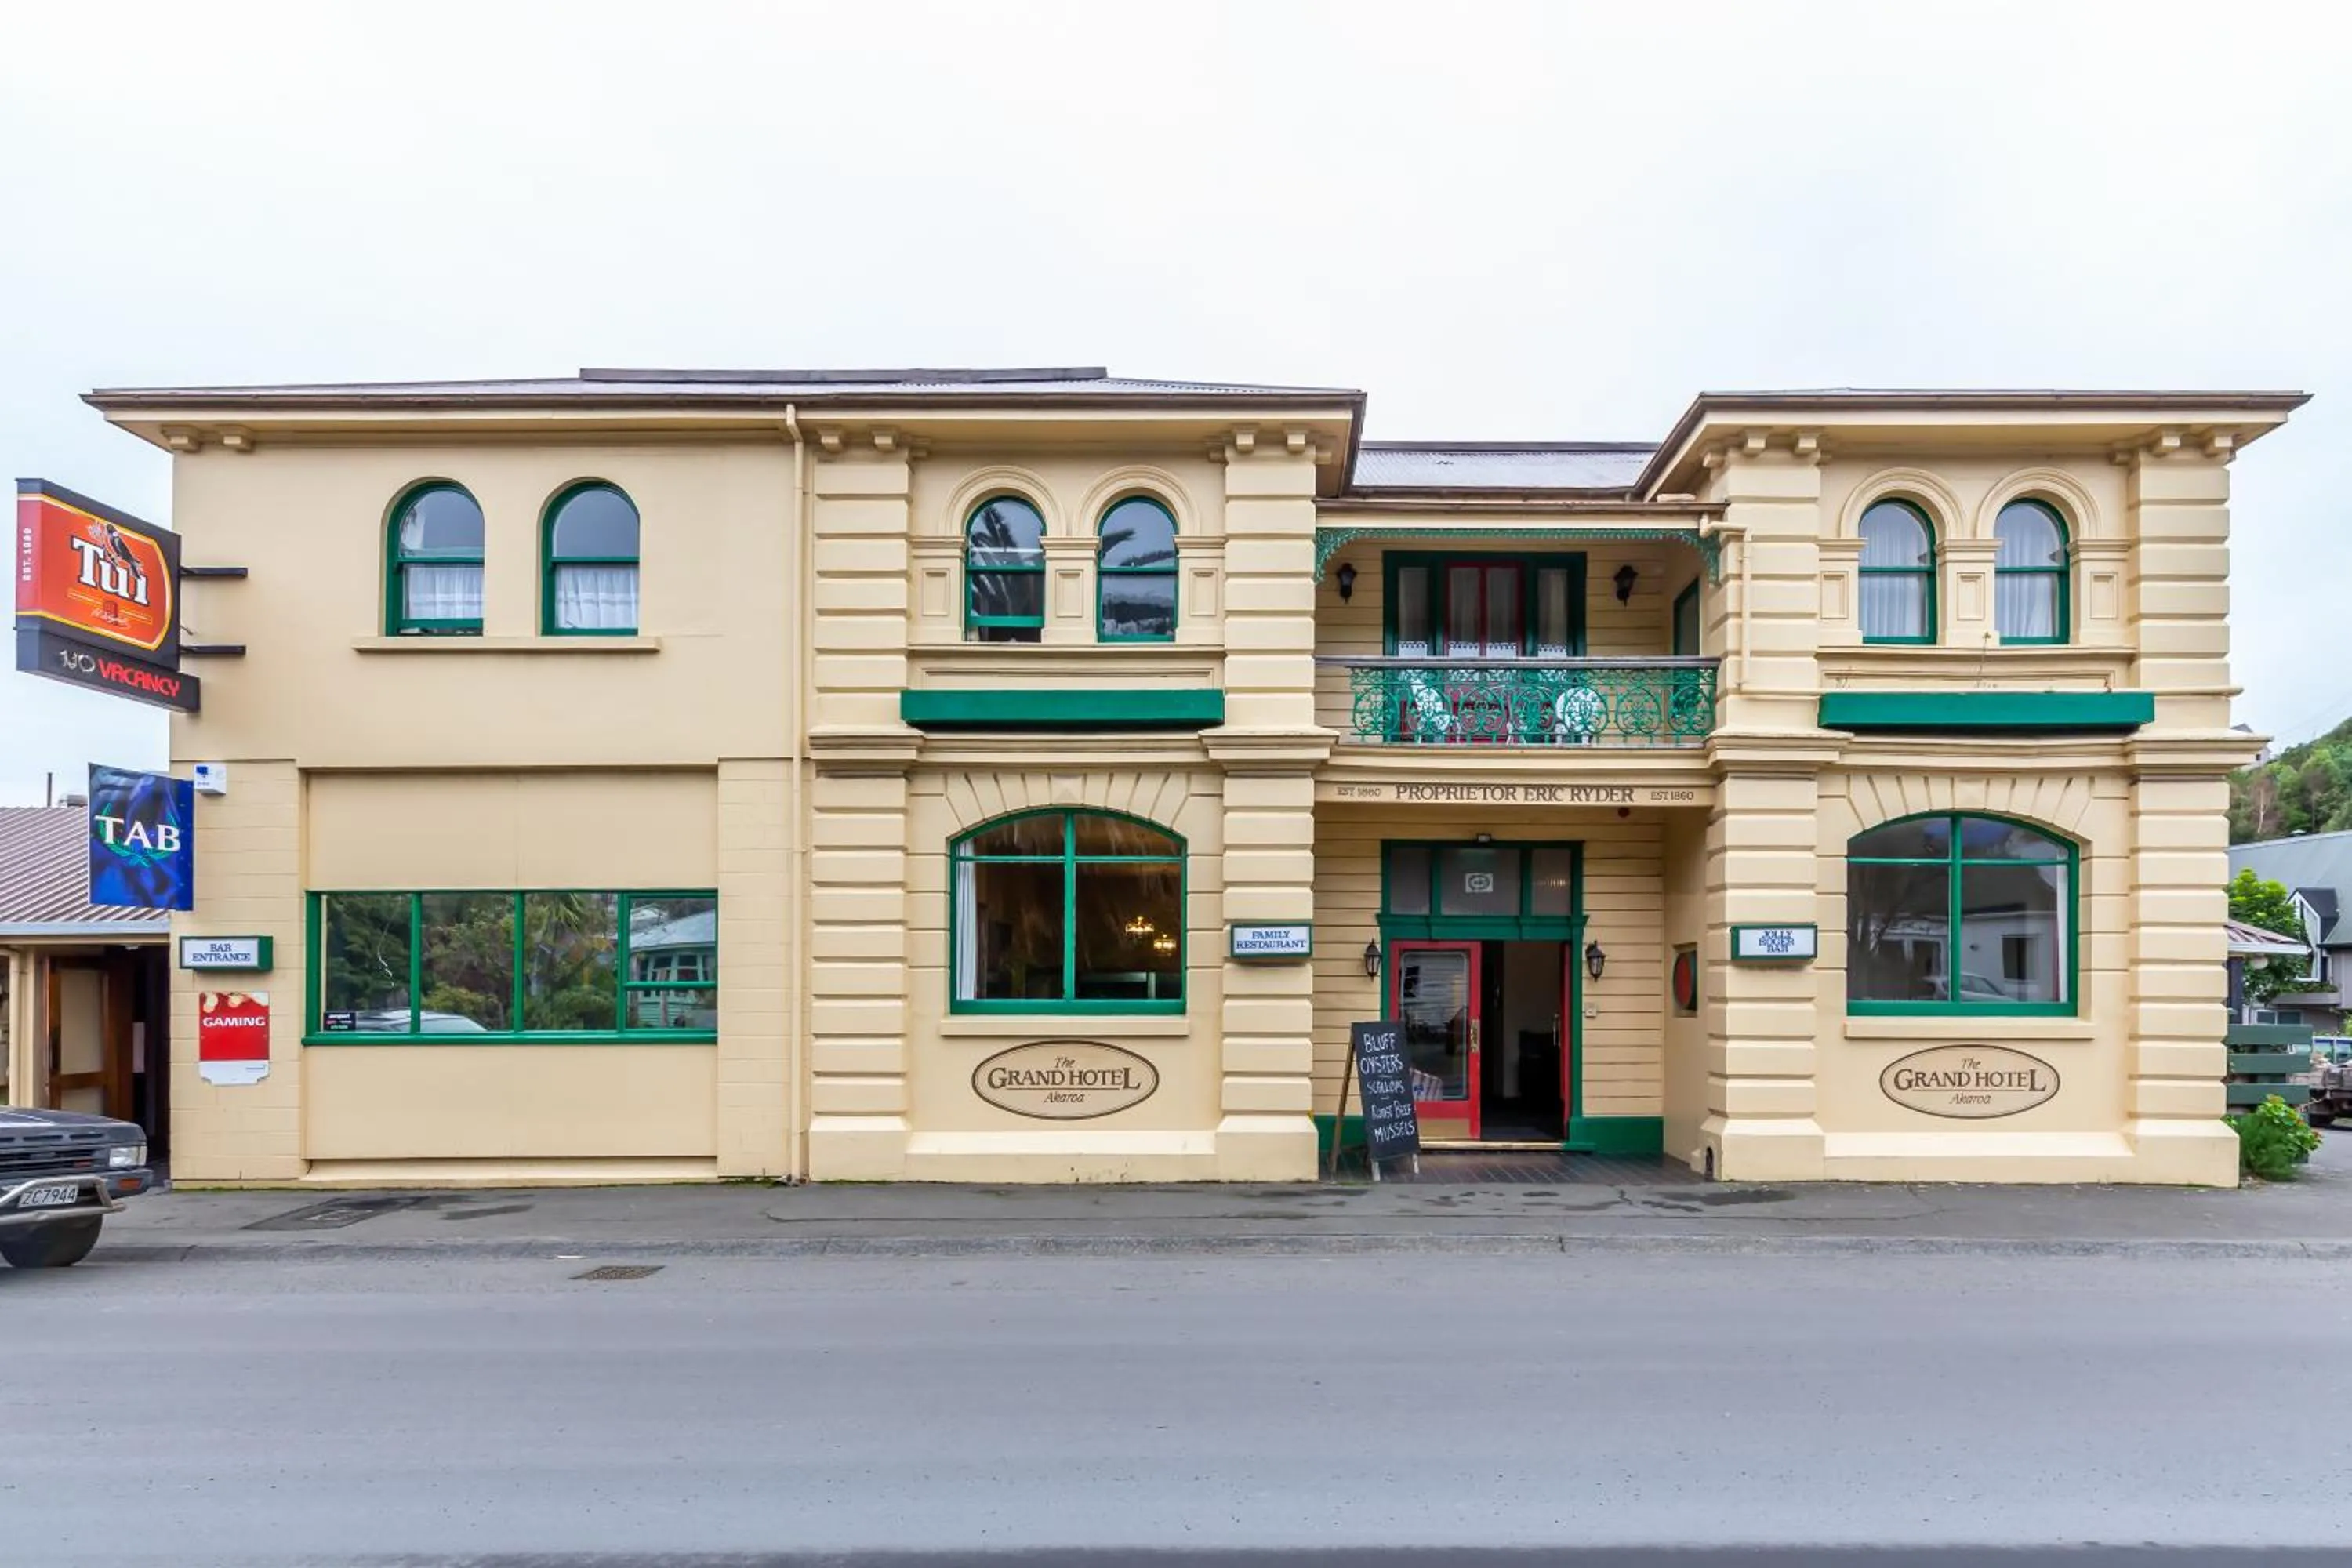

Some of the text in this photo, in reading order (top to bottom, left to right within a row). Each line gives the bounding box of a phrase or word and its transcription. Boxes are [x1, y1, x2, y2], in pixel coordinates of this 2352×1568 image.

[71, 535, 149, 606] Tui
[98, 657, 180, 697] VACANCY
[1337, 786, 1355, 797] EST
[1396, 784, 1517, 801] PROPRIETOR
[1523, 786, 1563, 802] ERIC
[1570, 786, 1635, 803] RYDER
[1650, 791, 1669, 800] EST
[1671, 791, 1694, 800] 1860
[95, 815, 181, 852] TAB
[1252, 931, 1290, 939] FAMILY
[210, 943, 232, 953] BAR
[1236, 940, 1305, 949] RESTAURANT
[192, 953, 251, 962] ENTRANCE
[202, 1016, 266, 1027] GAMING
[1363, 1033, 1396, 1053] BLUFF
[1055, 1056, 1075, 1068] The
[1360, 1054, 1403, 1075] OYSTERS
[1962, 1058, 1981, 1069] The
[987, 1067, 1141, 1089] GRAND HOTEL
[1893, 1069, 2047, 1091] GRAND HOTEL
[1367, 1080, 1405, 1094] SCALLOPS
[1044, 1091, 1086, 1103] Akaroa
[1949, 1093, 1991, 1105] Akaroa
[1374, 1120, 1415, 1142] MUSSELS
